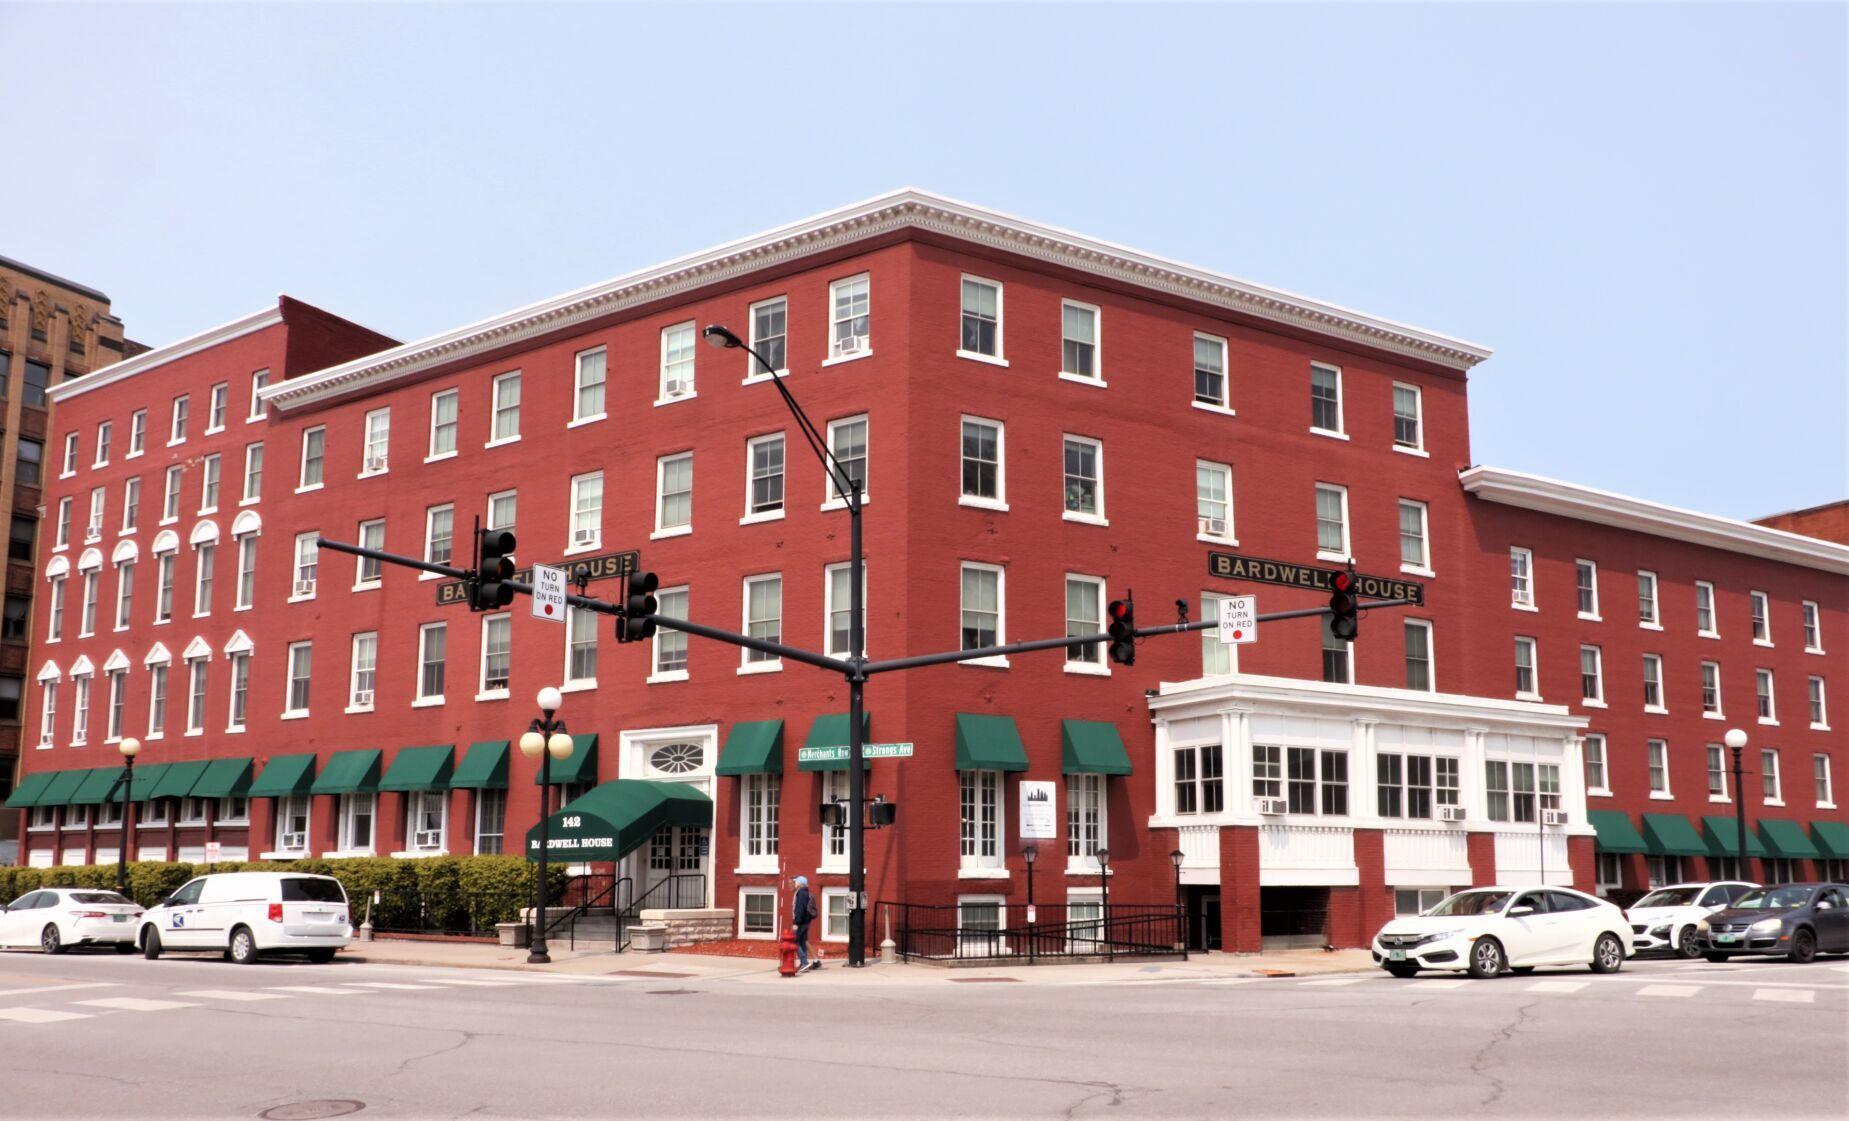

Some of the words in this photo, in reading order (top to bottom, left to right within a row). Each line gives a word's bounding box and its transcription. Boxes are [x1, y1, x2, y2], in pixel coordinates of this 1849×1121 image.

[543, 570, 558, 582] NO
[541, 581, 560, 593] TURN
[536, 591, 546, 601] ON
[549, 594, 563, 604] RED
[1229, 600, 1245, 610] NO
[1227, 611, 1248, 619] TURN
[1222, 621, 1234, 629] ON
[1237, 620, 1253, 628] RED
[899, 744, 911, 754] Ave
[562, 816, 581, 828] 142
[581, 838, 613, 848] HOUSE
